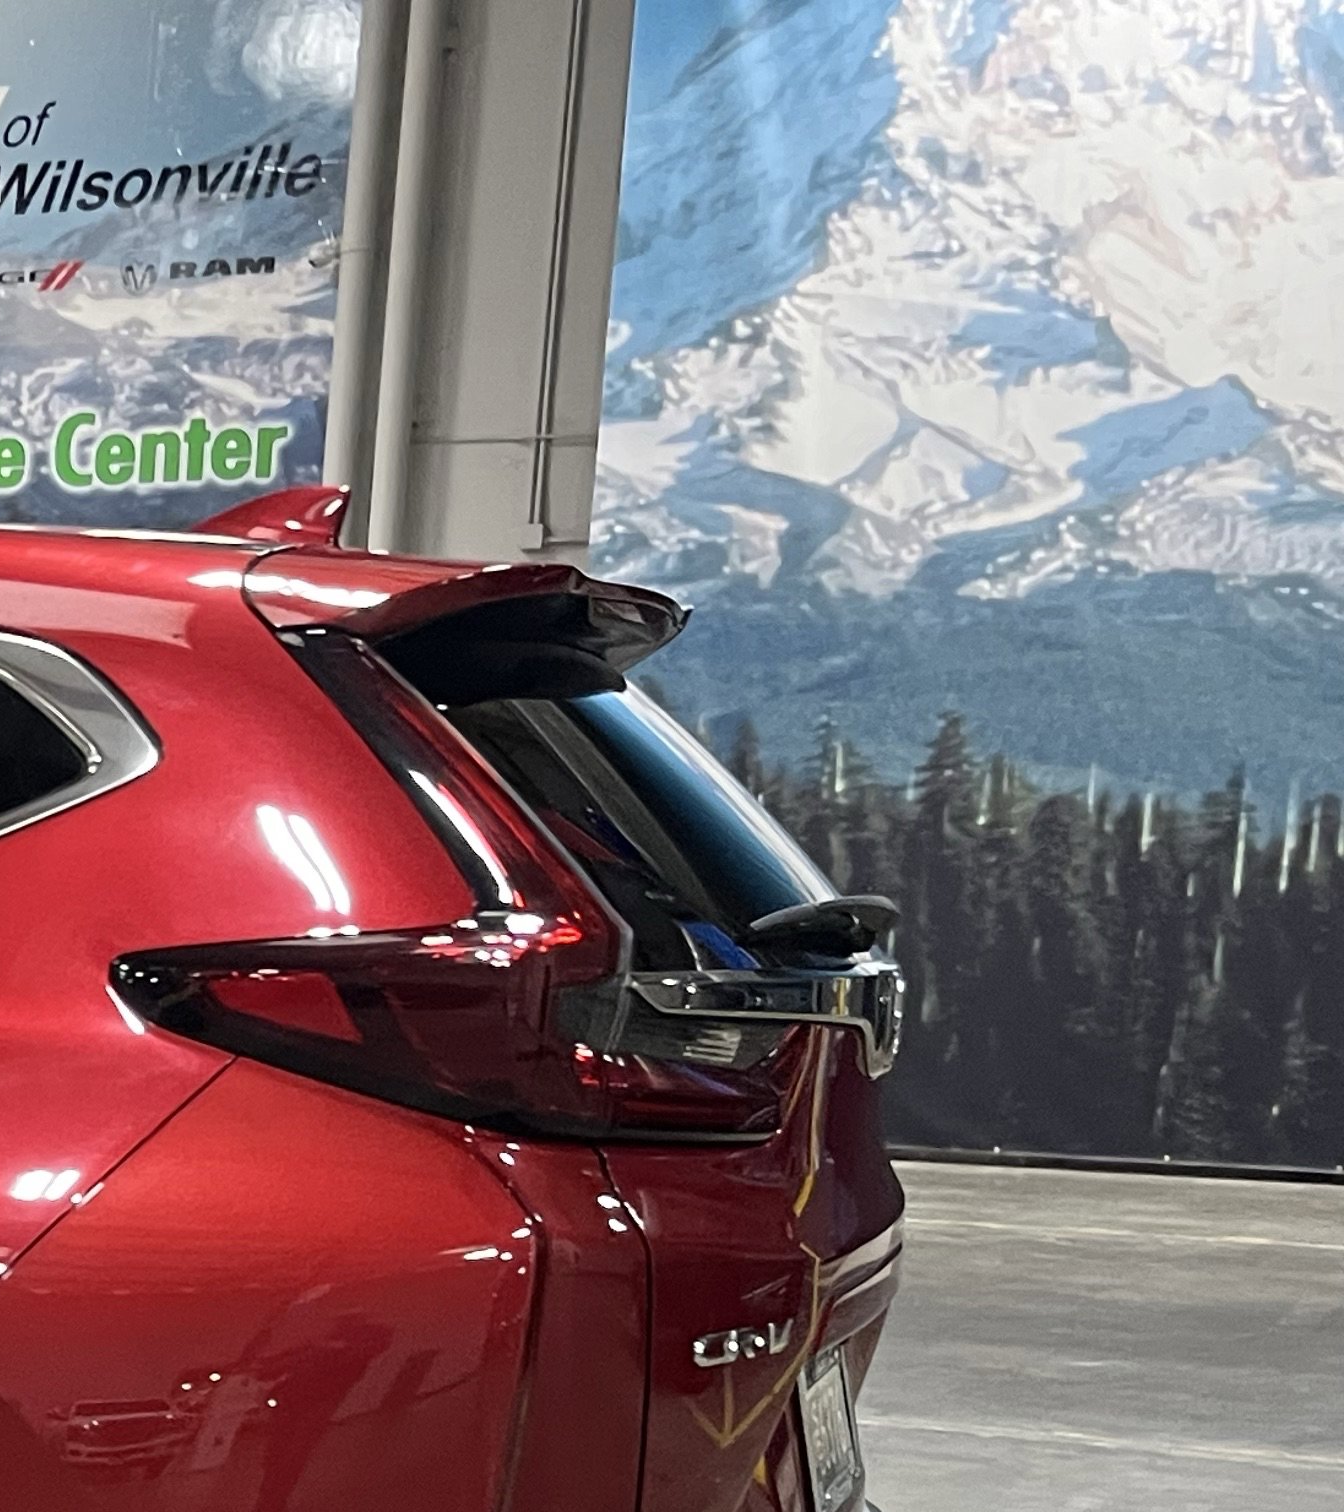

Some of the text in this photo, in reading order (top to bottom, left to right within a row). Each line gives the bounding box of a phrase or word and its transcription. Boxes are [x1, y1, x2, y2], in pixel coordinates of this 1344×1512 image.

[2, 101, 57, 148] of
[169, 256, 276, 280] RAM
[54, 412, 289, 487] Center
